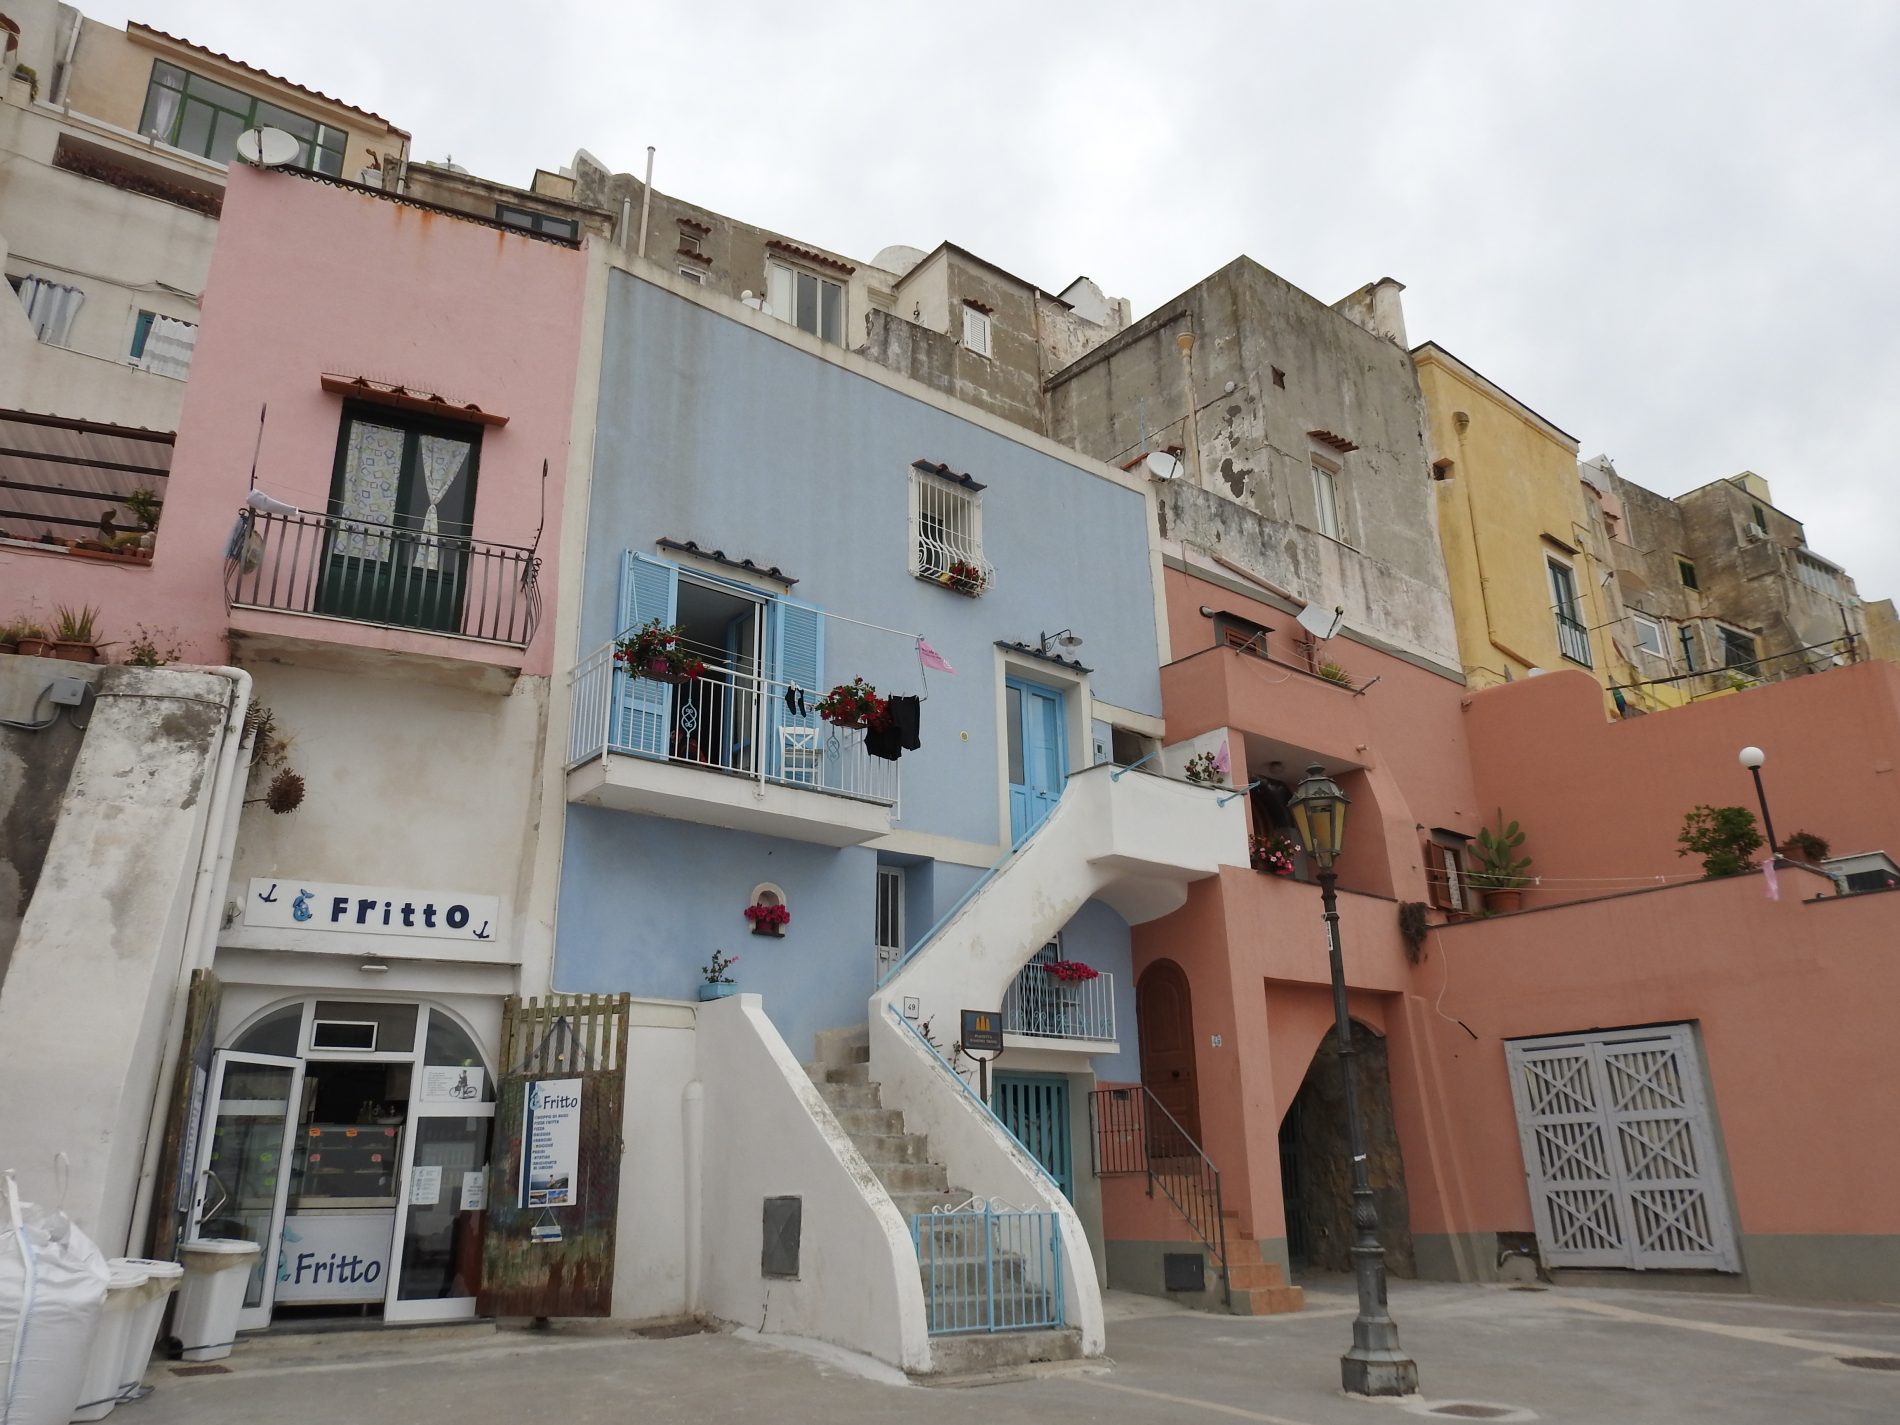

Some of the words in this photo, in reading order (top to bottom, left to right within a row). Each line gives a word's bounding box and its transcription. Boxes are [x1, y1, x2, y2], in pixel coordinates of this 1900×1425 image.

[331, 897, 470, 929] Fritto
[907, 1003, 916, 1011] 49
[543, 1095, 578, 1110] Fritto
[295, 1253, 381, 1285] Fritto
